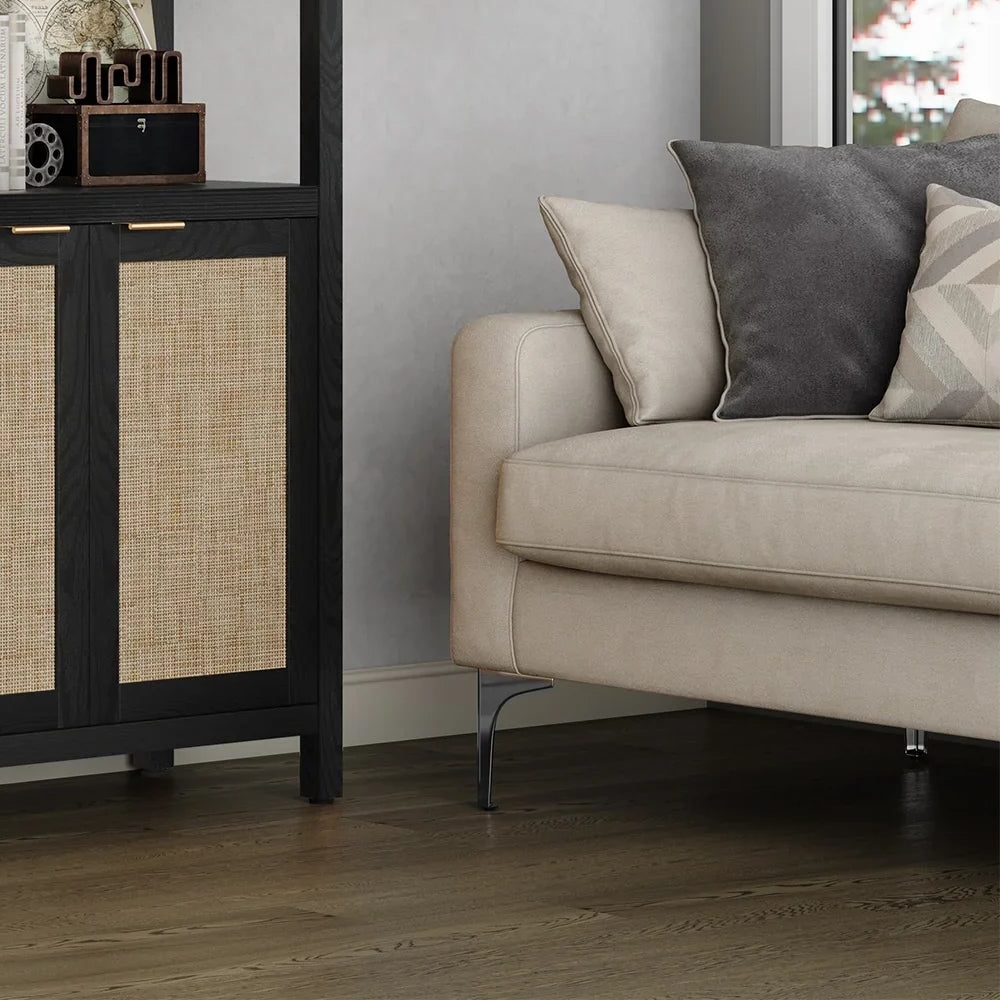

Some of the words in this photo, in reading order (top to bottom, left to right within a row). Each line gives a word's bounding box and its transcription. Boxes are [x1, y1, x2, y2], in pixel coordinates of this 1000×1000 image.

[0, 28, 7, 79] LATINARUM
[0, 82, 7, 114] VOCUM
[0, 118, 7, 165] LATERCULI
